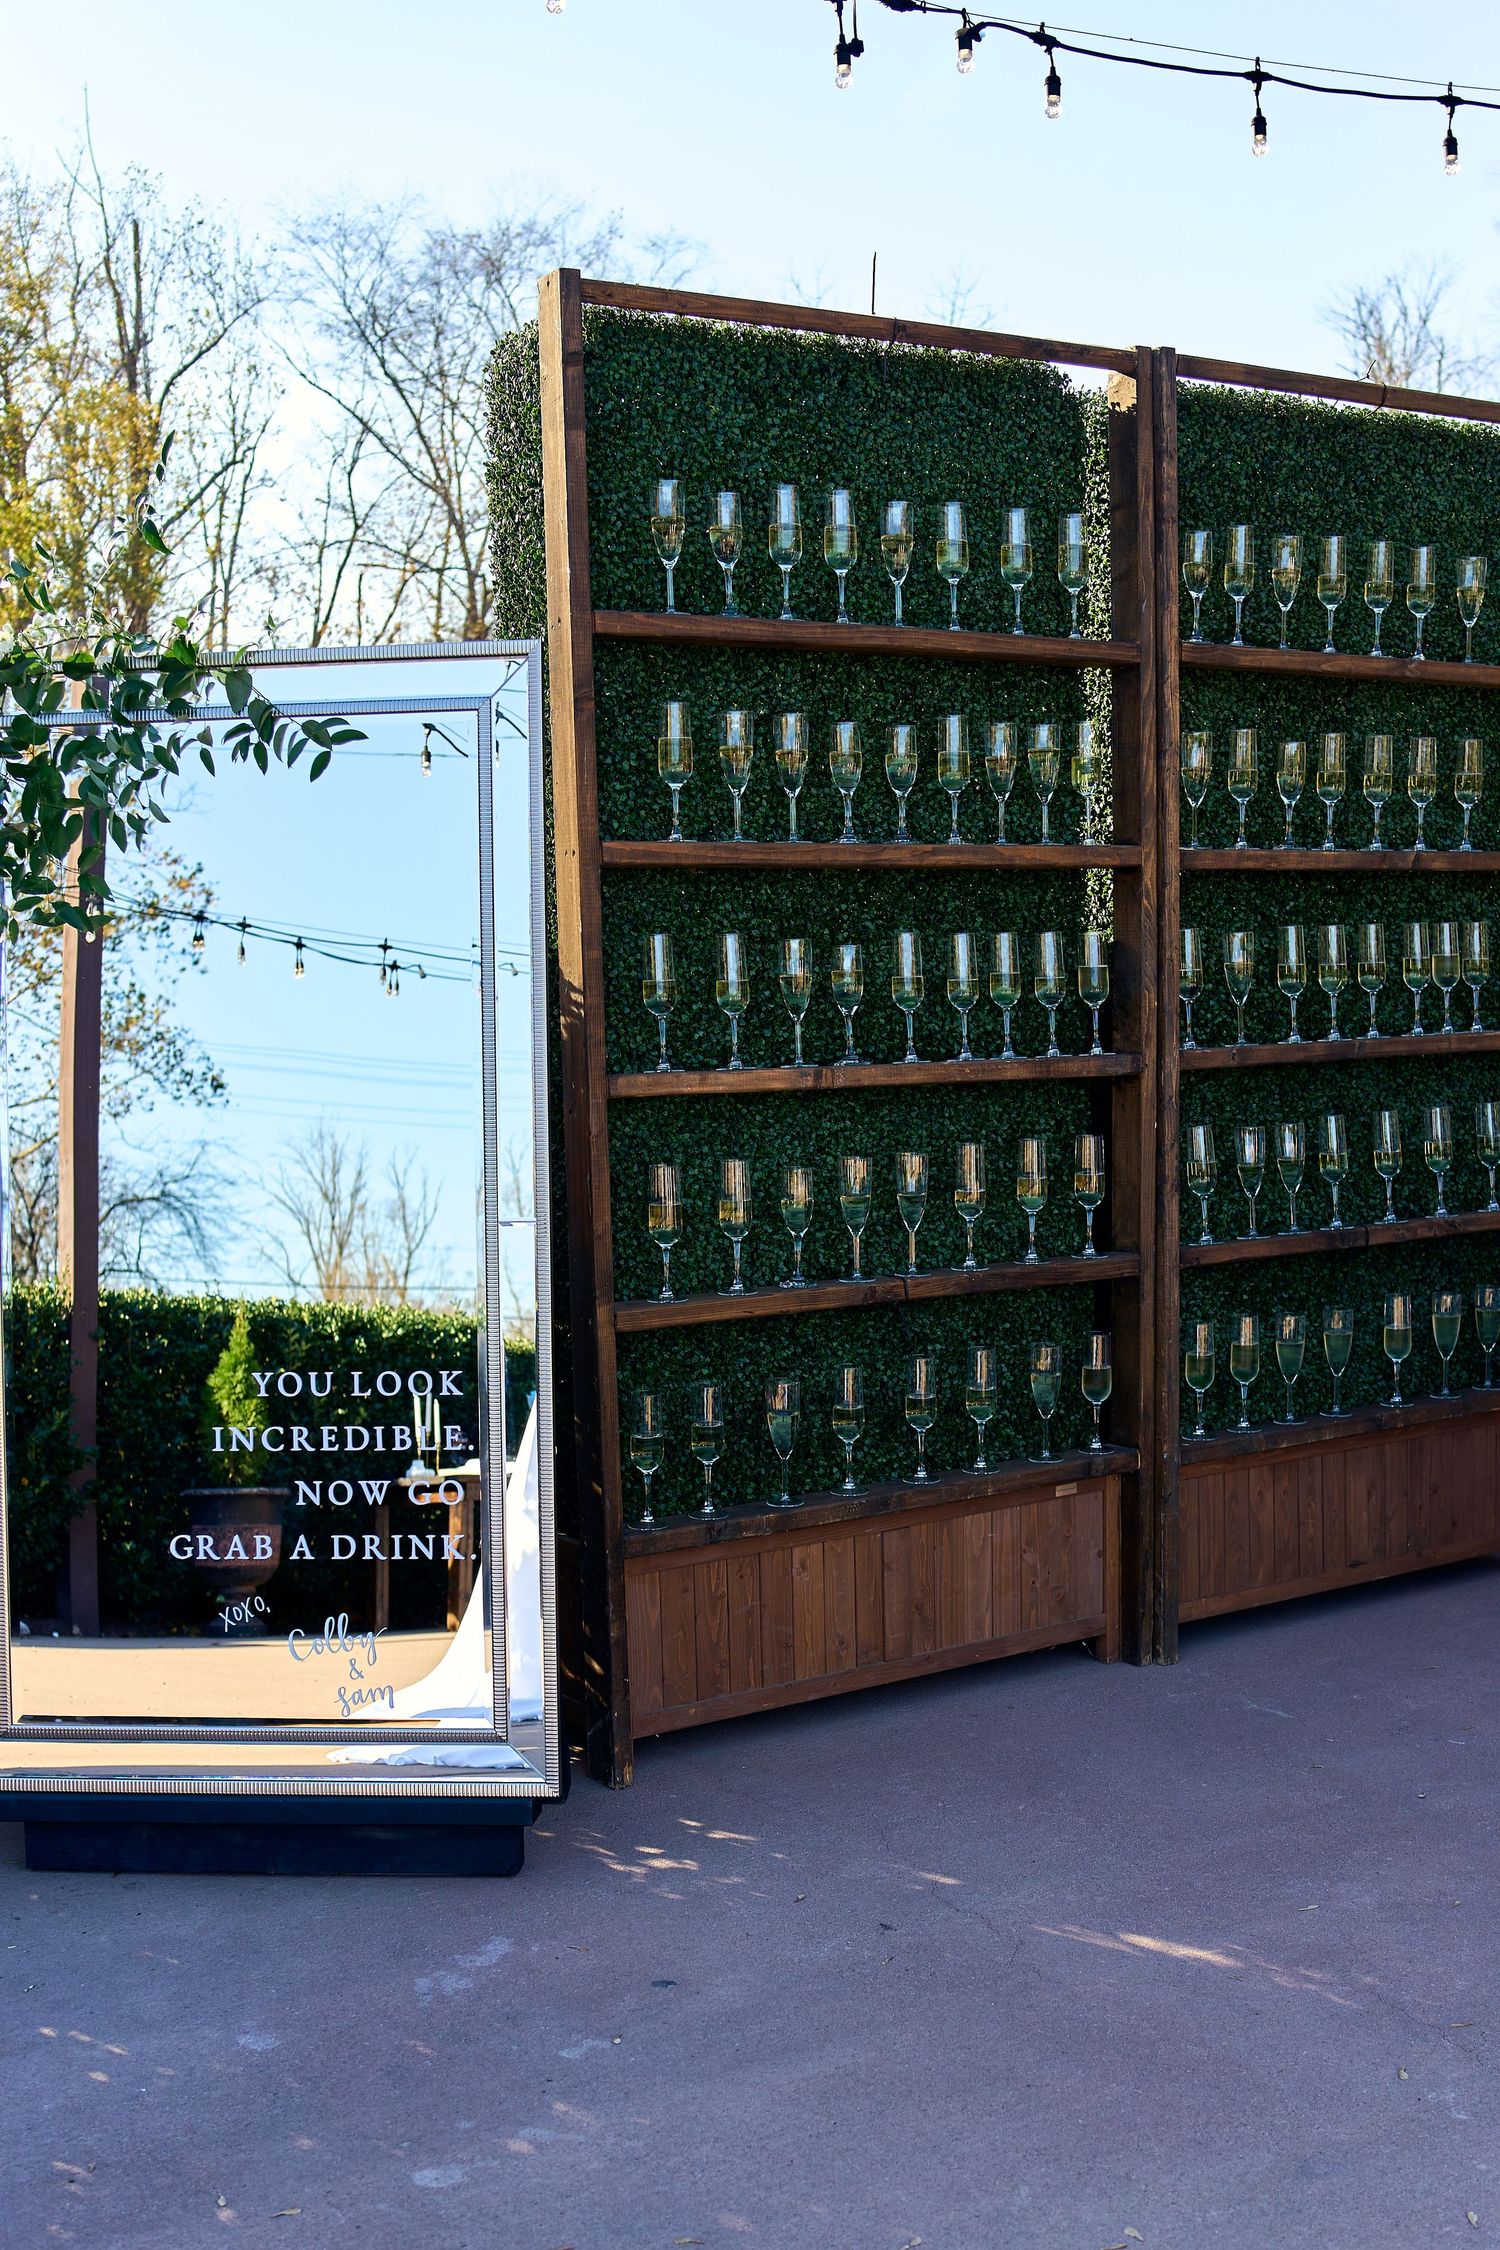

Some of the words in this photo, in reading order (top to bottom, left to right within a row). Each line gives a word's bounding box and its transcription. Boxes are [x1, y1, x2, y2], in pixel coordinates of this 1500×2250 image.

[251, 1371, 334, 1397] YOU
[350, 1370, 464, 1397] LOOK
[211, 1425, 475, 1452] INCREDIBLE.
[294, 1480, 392, 1506] NOW
[407, 1479, 465, 1506] GO
[169, 1534, 273, 1561] GRAB
[289, 1534, 315, 1560] A
[330, 1534, 477, 1561] DRINK.
[287, 1612, 388, 1666] Colby
[348, 1657, 365, 1681] &
